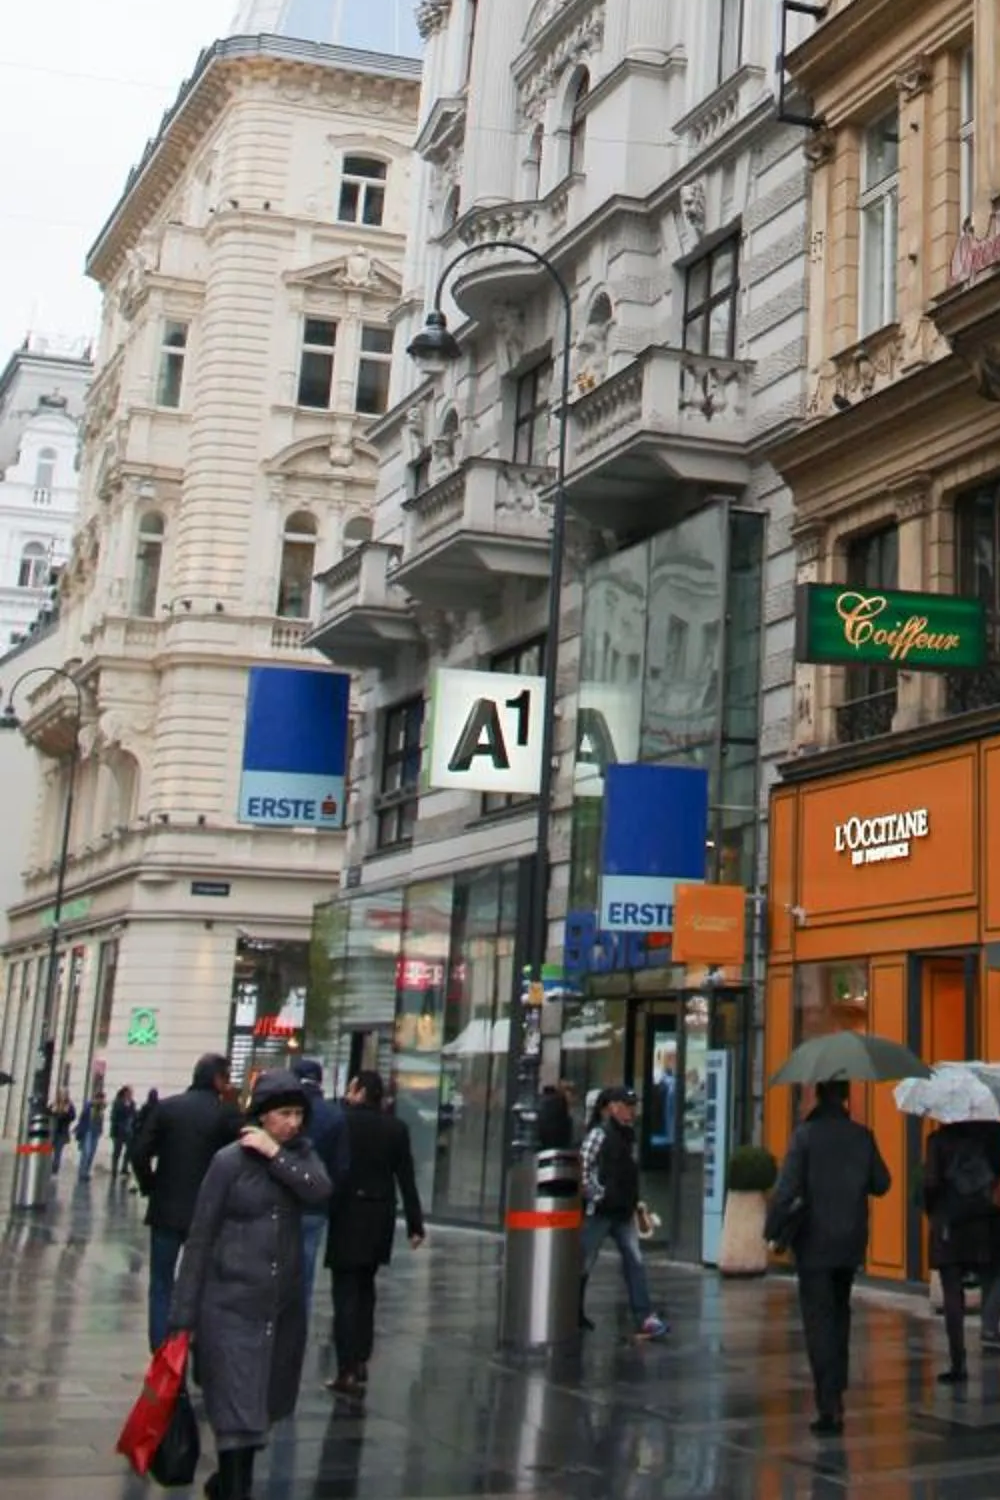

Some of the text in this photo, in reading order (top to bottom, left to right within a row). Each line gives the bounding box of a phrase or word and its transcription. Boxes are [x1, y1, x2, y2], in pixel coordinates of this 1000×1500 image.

[836, 591, 960, 660] Coiffeur
[448, 689, 531, 772] A1
[248, 797, 316, 820] ERSTE
